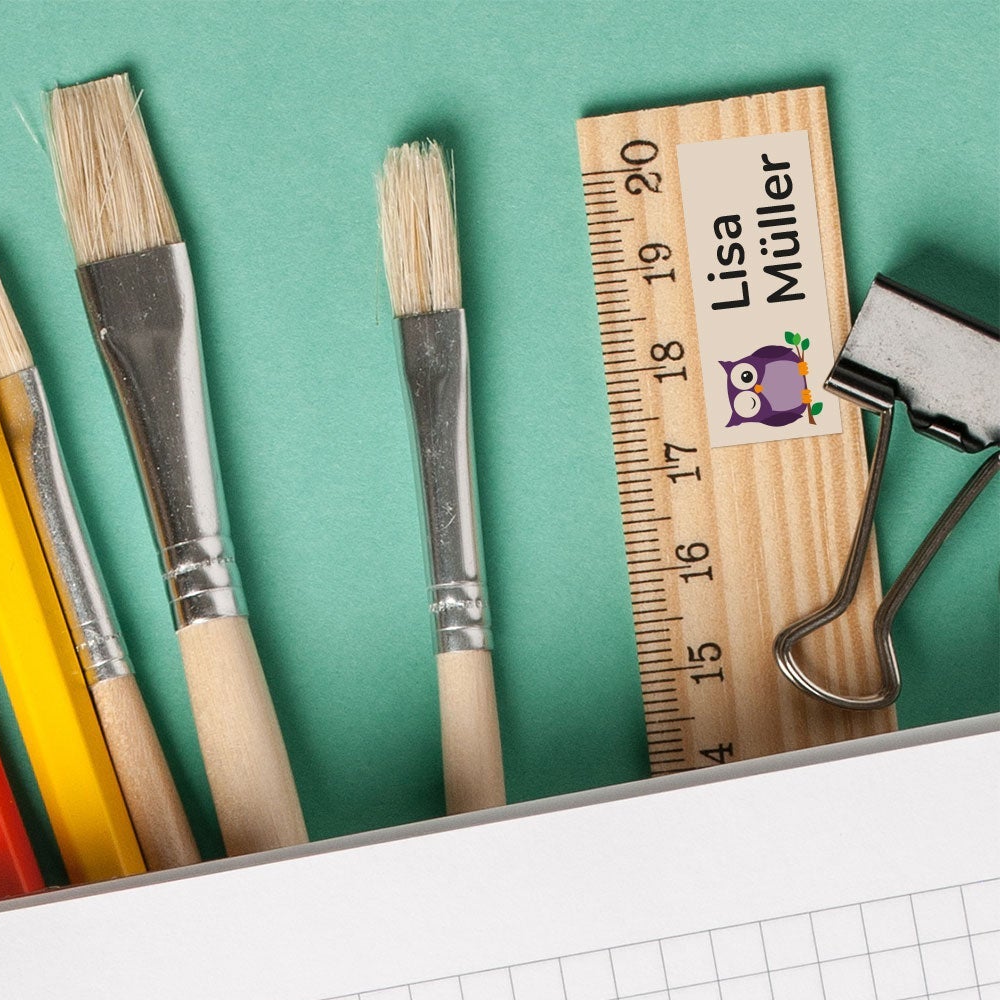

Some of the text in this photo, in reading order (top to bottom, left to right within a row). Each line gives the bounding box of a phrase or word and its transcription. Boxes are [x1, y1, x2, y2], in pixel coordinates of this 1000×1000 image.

[620, 139, 662, 195] 20
[756, 153, 806, 304] Müller
[638, 242, 676, 285] 19
[707, 214, 751, 311] Lisa
[650, 340, 688, 384] 18
[664, 443, 702, 484] 17
[675, 541, 714, 583] 16
[687, 641, 725, 685] 15
[700, 741, 734, 765] 4
